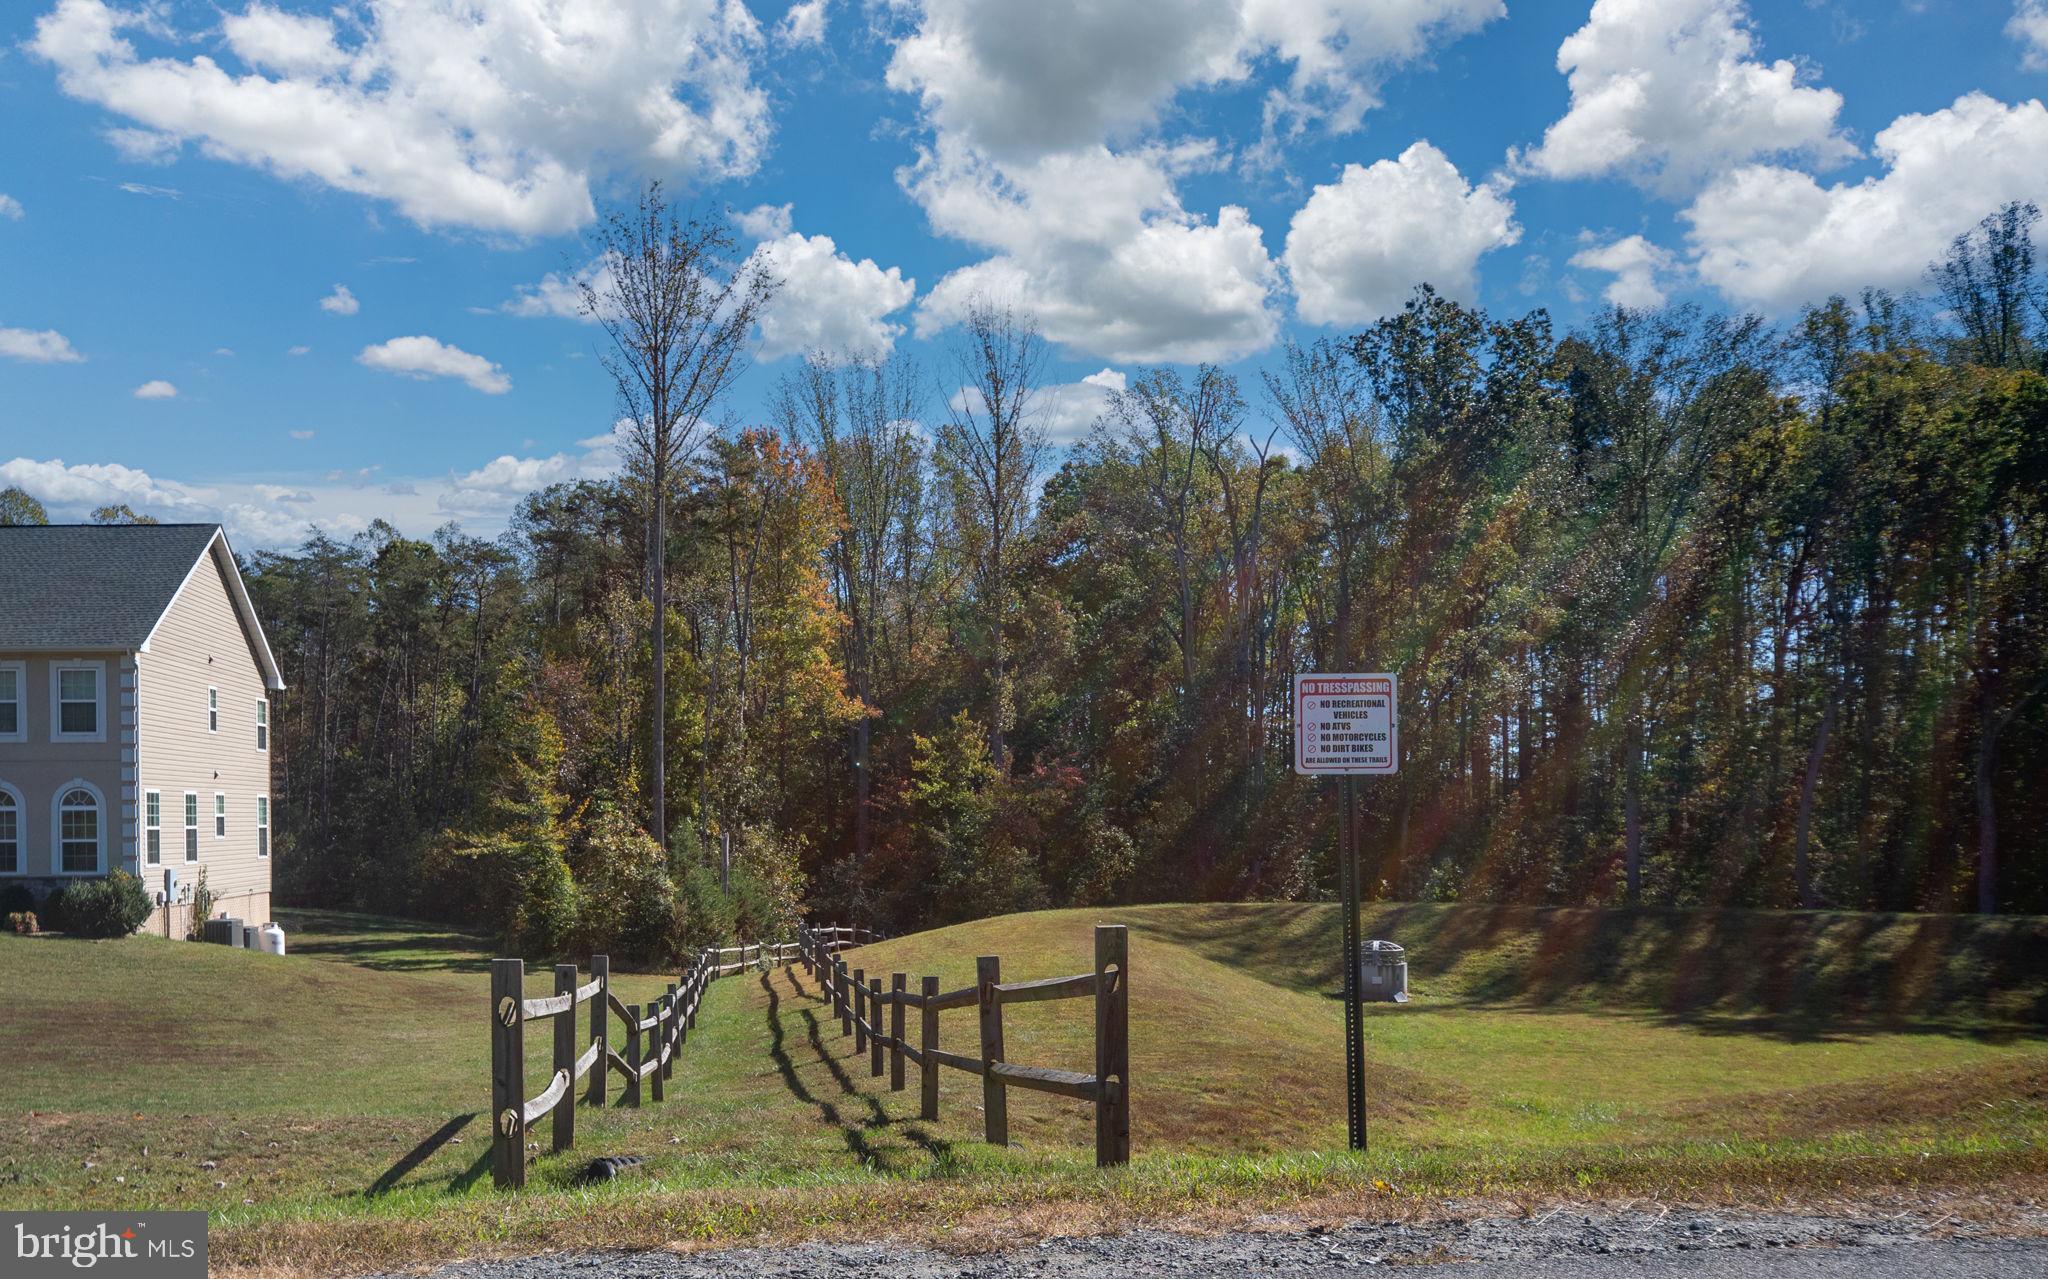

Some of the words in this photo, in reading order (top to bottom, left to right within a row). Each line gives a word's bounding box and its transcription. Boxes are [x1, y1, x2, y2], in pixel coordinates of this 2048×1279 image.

[1302, 683, 1316, 693] NO
[1318, 682, 1390, 693] TRESSPASSING
[1332, 733, 1386, 741] MOTORCYCLES
